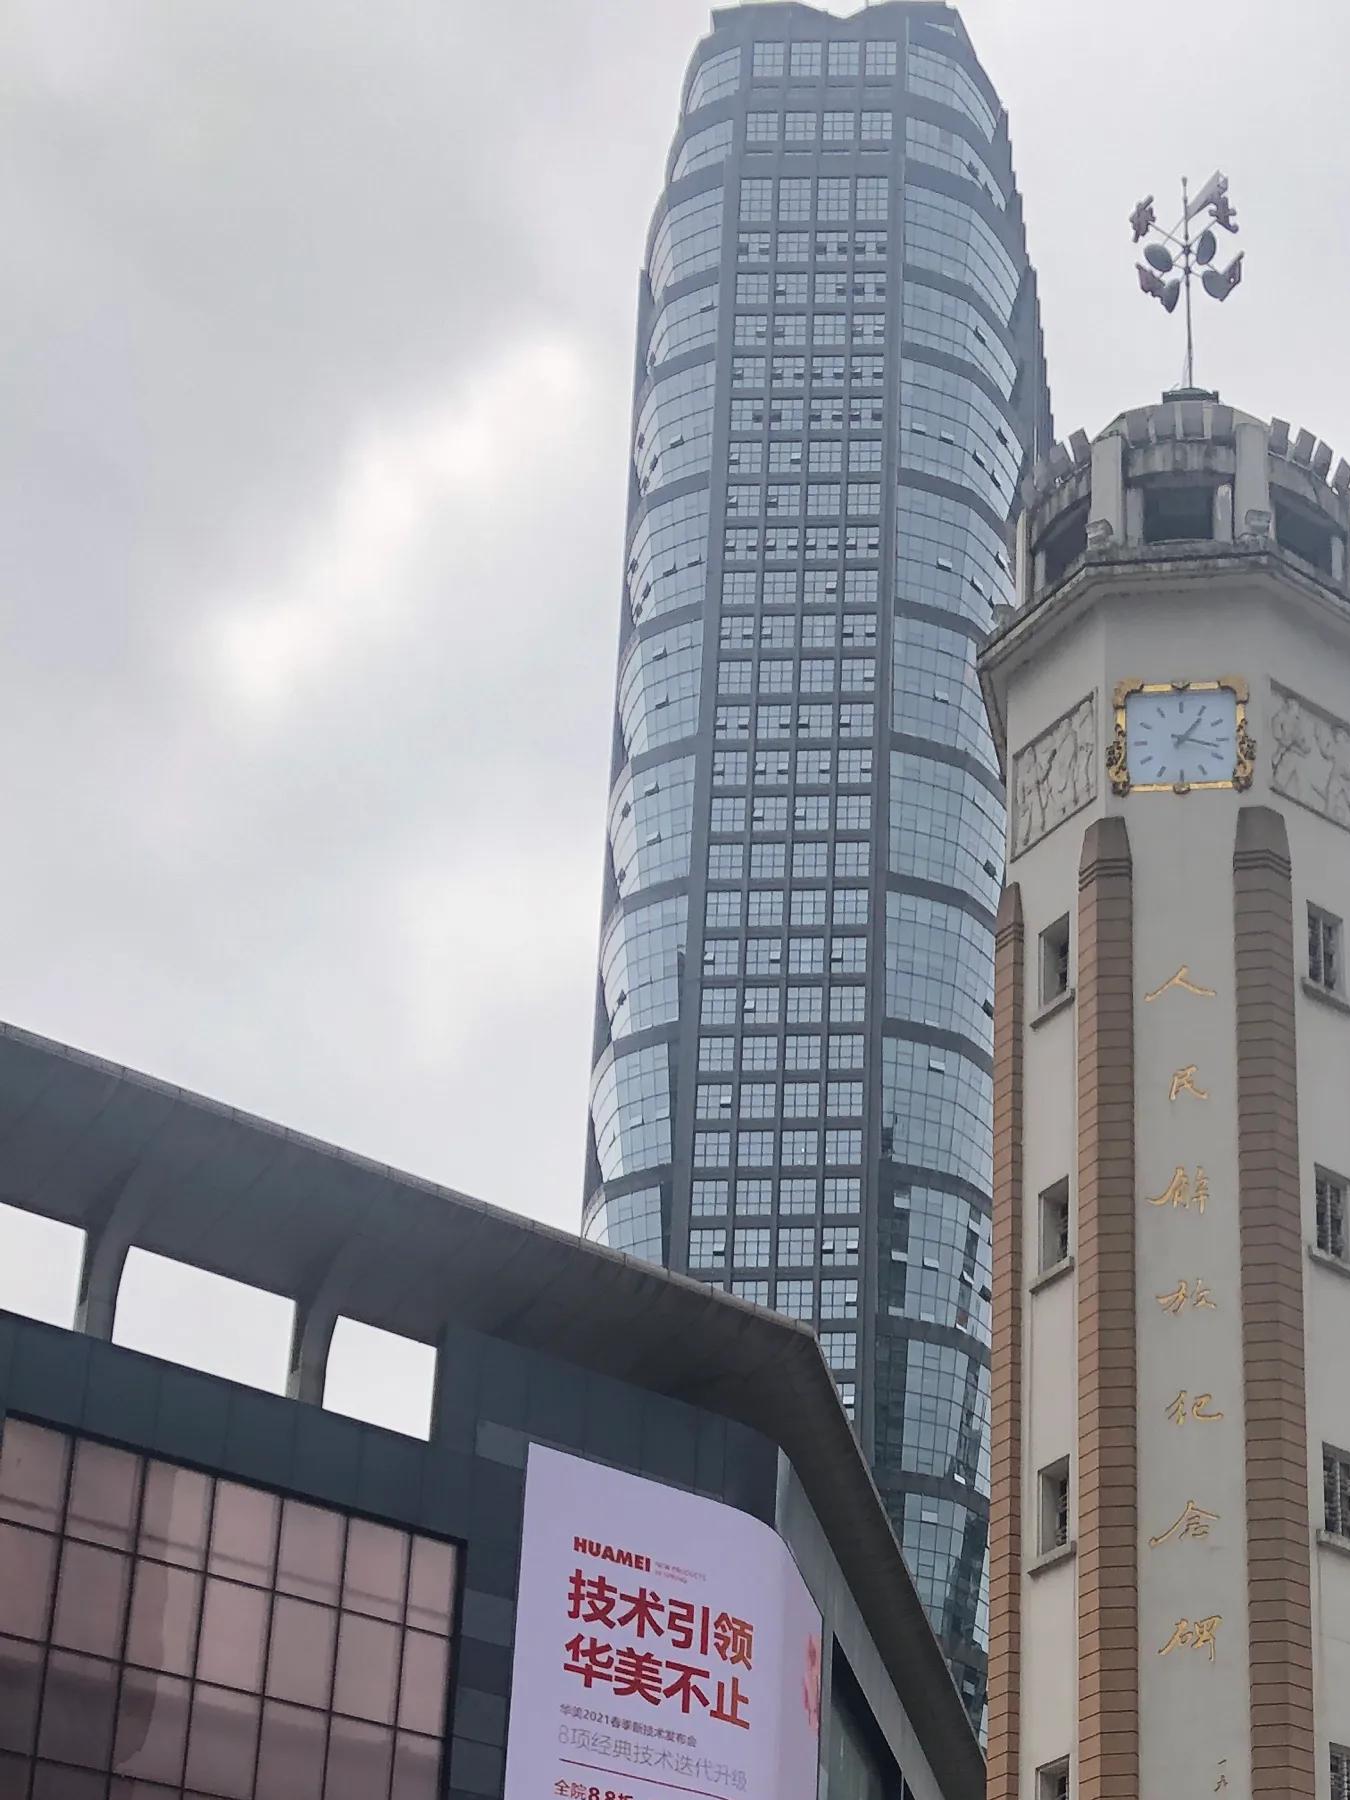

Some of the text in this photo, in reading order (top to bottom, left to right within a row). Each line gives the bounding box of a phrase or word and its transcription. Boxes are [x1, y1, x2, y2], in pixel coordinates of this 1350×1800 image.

[572, 1535, 651, 1573] HUAMEI
[567, 1568, 755, 1672] 技术引领
[563, 1632, 751, 1731] 华美不止
